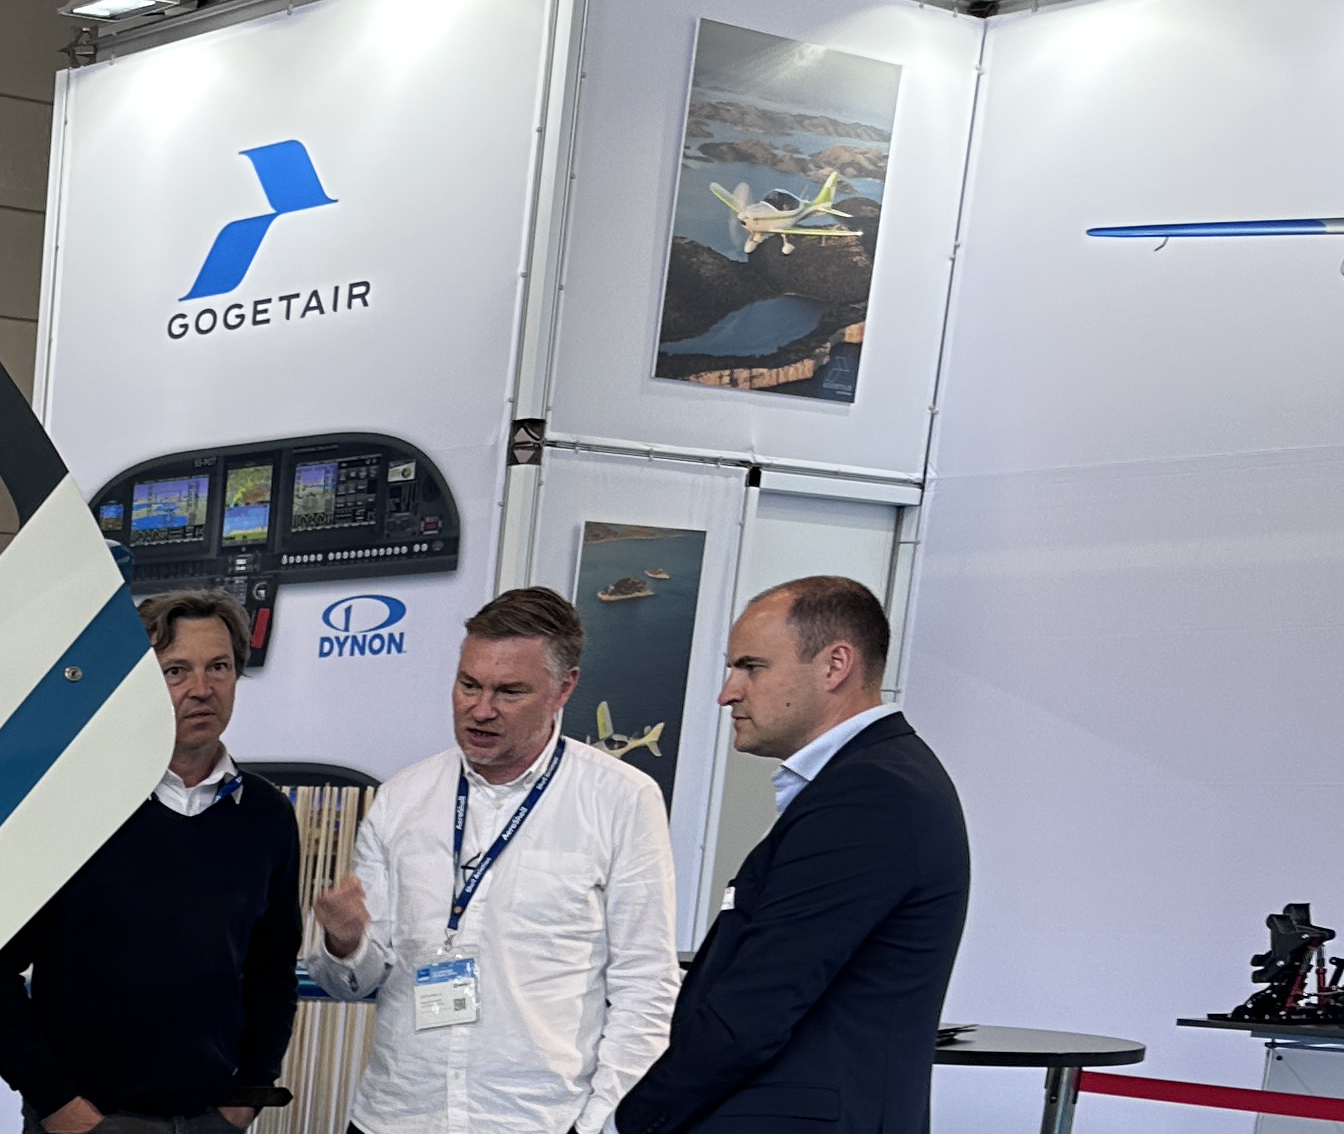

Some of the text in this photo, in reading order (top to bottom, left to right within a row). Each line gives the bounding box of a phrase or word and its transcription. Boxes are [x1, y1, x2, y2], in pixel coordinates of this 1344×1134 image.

[167, 281, 372, 340] GOGETAIR
[319, 632, 405, 658] DYNON
[501, 806, 528, 840] AeroShell
